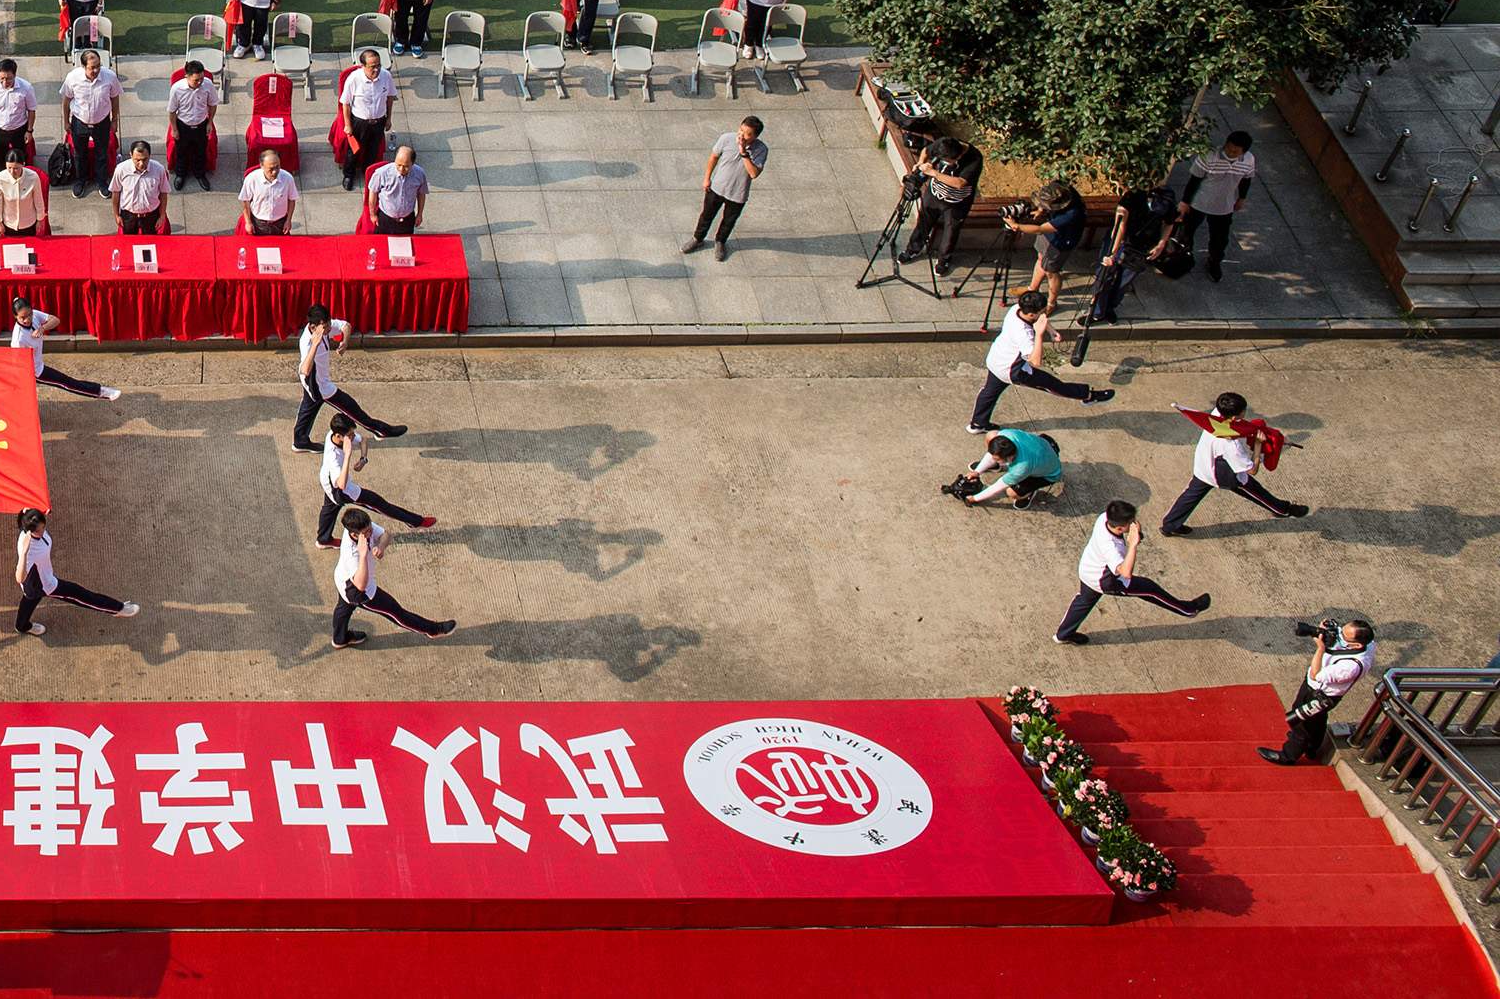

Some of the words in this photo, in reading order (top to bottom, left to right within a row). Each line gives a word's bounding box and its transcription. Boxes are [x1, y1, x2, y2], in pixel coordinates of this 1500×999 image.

[754, 725, 803, 734] HIGH
[697, 730, 743, 763] SCHOOL
[762, 736, 800, 745] 1920
[821, 730, 884, 762] WUHAN
